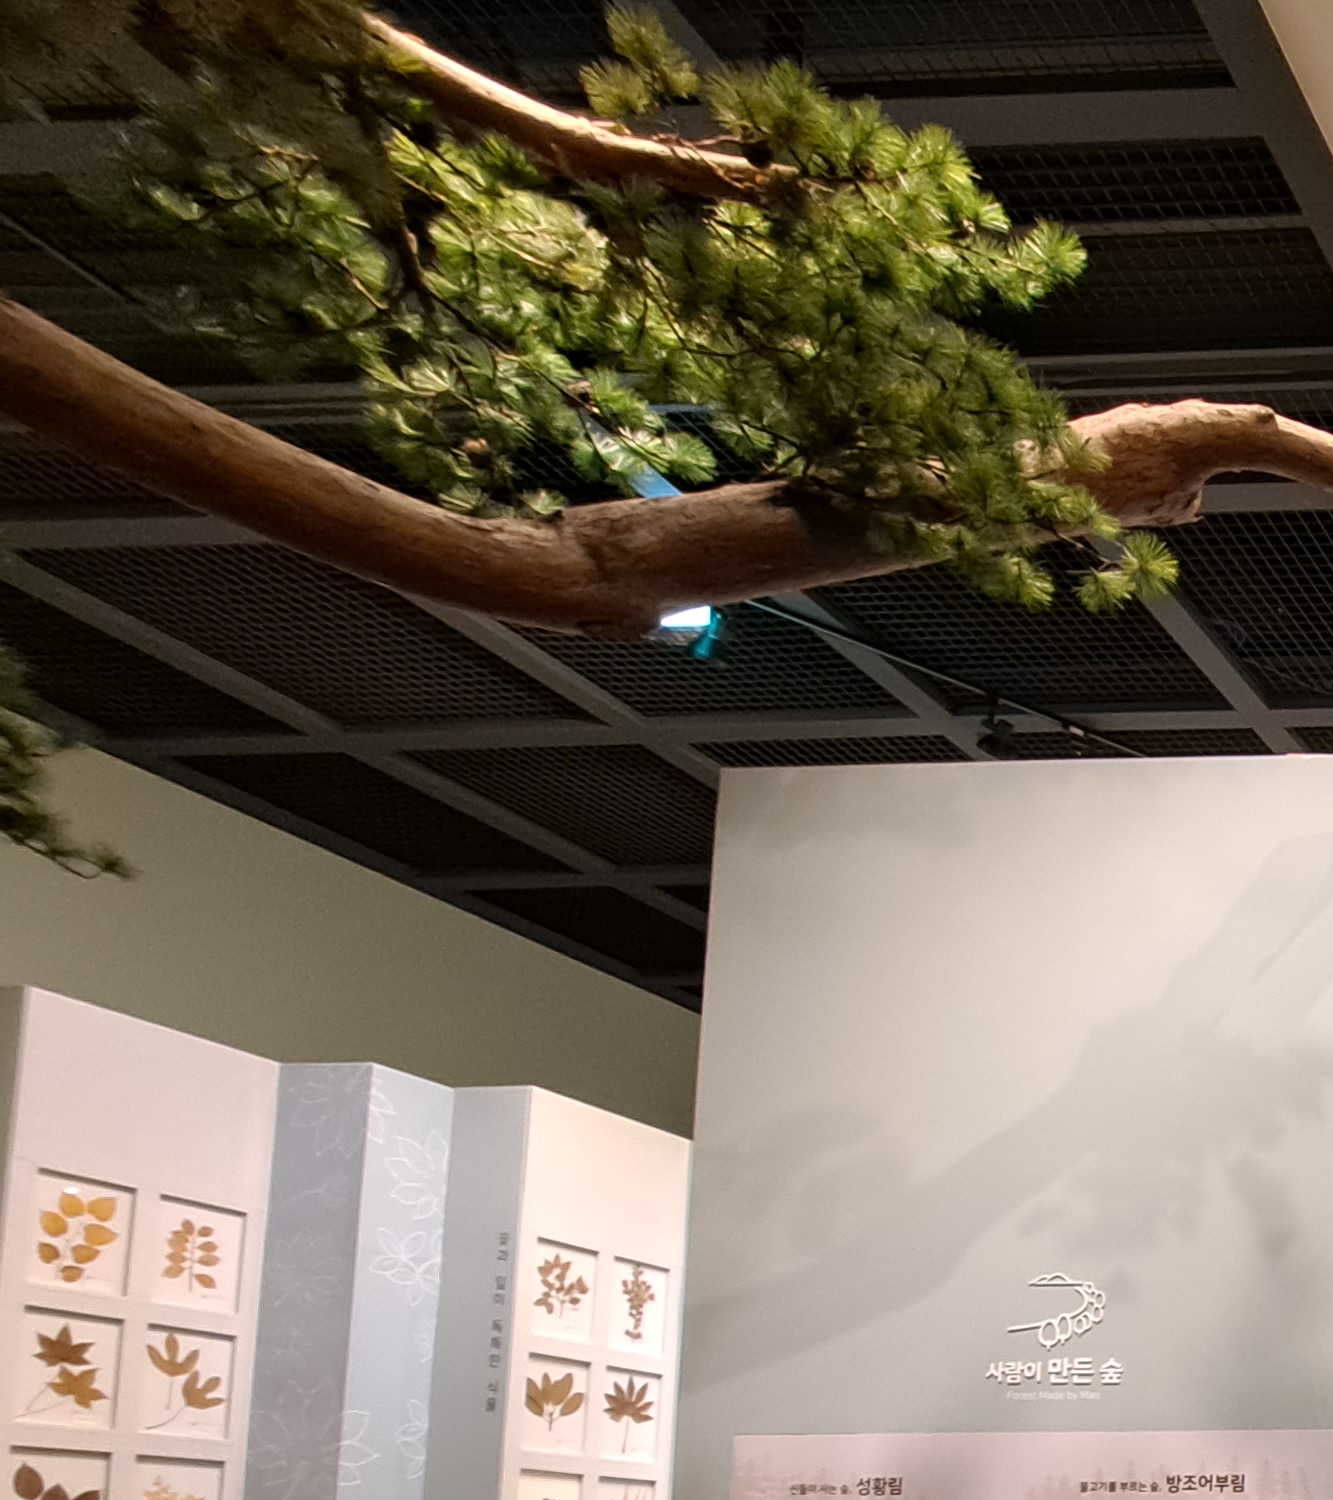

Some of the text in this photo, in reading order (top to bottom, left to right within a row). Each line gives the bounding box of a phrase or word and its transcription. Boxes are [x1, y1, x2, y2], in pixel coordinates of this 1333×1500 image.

[986, 1357, 1124, 1385] 사람이 만든 숲
[856, 1477, 903, 1496] 성황림
[1120, 1482, 1148, 1493] 부르는
[1166, 1474, 1246, 1493] 방조어부림
